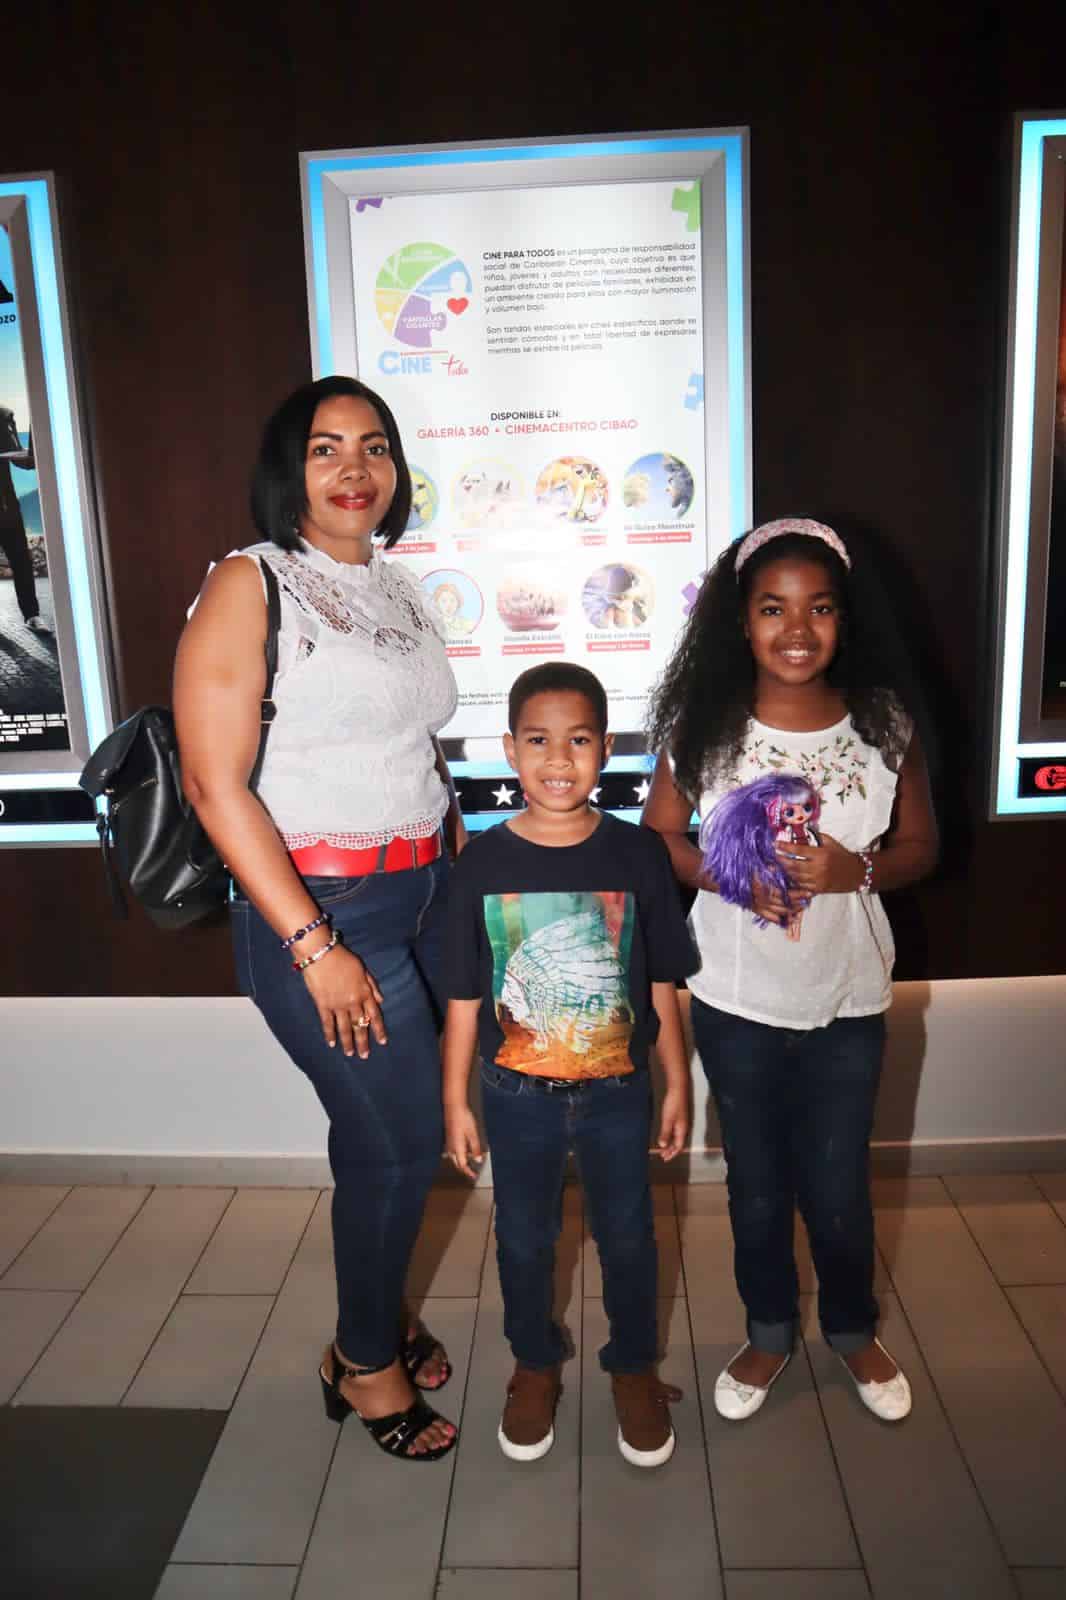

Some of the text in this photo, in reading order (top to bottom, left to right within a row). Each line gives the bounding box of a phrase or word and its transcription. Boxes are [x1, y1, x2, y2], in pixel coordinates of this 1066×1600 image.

[483, 251, 501, 260] CINE
[503, 250, 525, 259] PARA
[526, 248, 555, 257] TODOS
[377, 350, 432, 376] CINE
[490, 410, 545, 422] DISPONIBLE
[468, 425, 490, 437] 360
[505, 420, 597, 435] CINEMACENTRO
[599, 418, 639, 431] CIBAO
